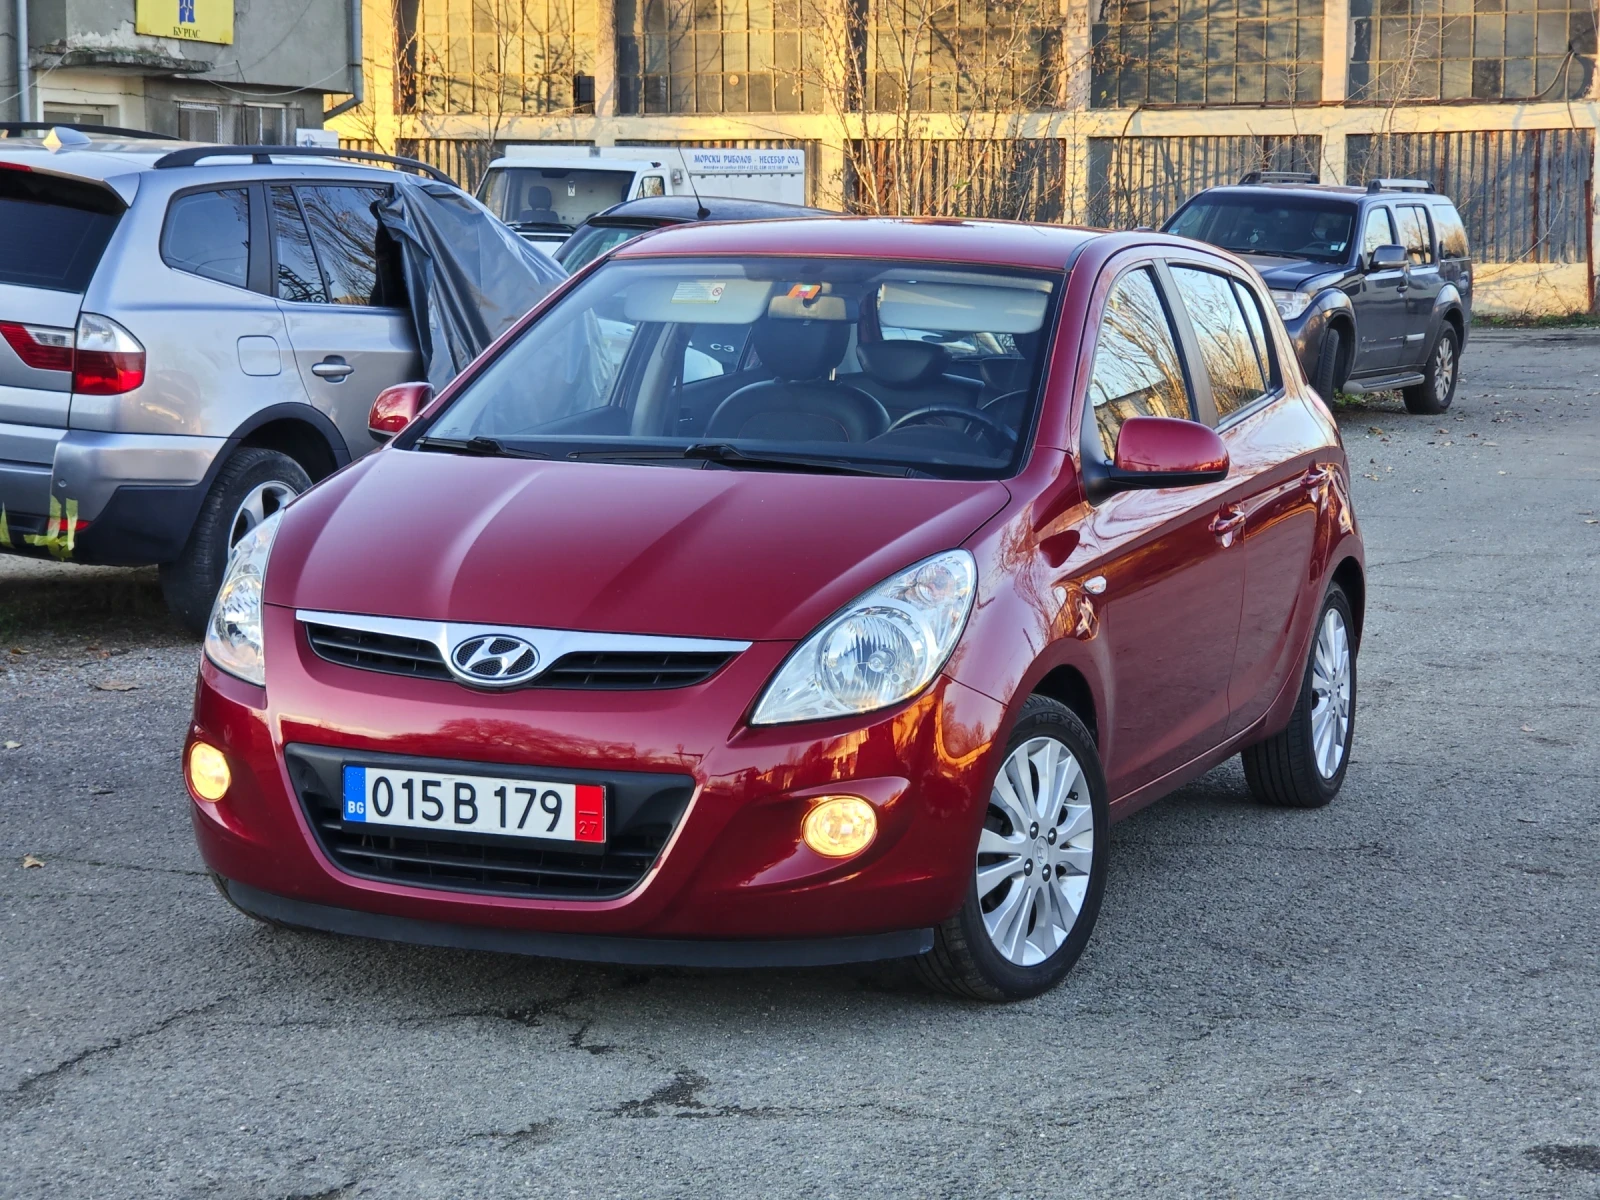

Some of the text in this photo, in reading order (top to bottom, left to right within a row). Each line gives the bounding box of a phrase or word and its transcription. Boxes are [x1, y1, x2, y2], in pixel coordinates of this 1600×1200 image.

[173, 26, 201, 39] БУРГАС
[694, 154, 720, 164] МОРСКИ
[723, 155, 752, 164] РИБОЛОВ
[759, 155, 785, 165] НЕСЕБЪР
[787, 156, 800, 166] ООД
[347, 800, 365, 815] BG
[578, 820, 598, 836] 27
